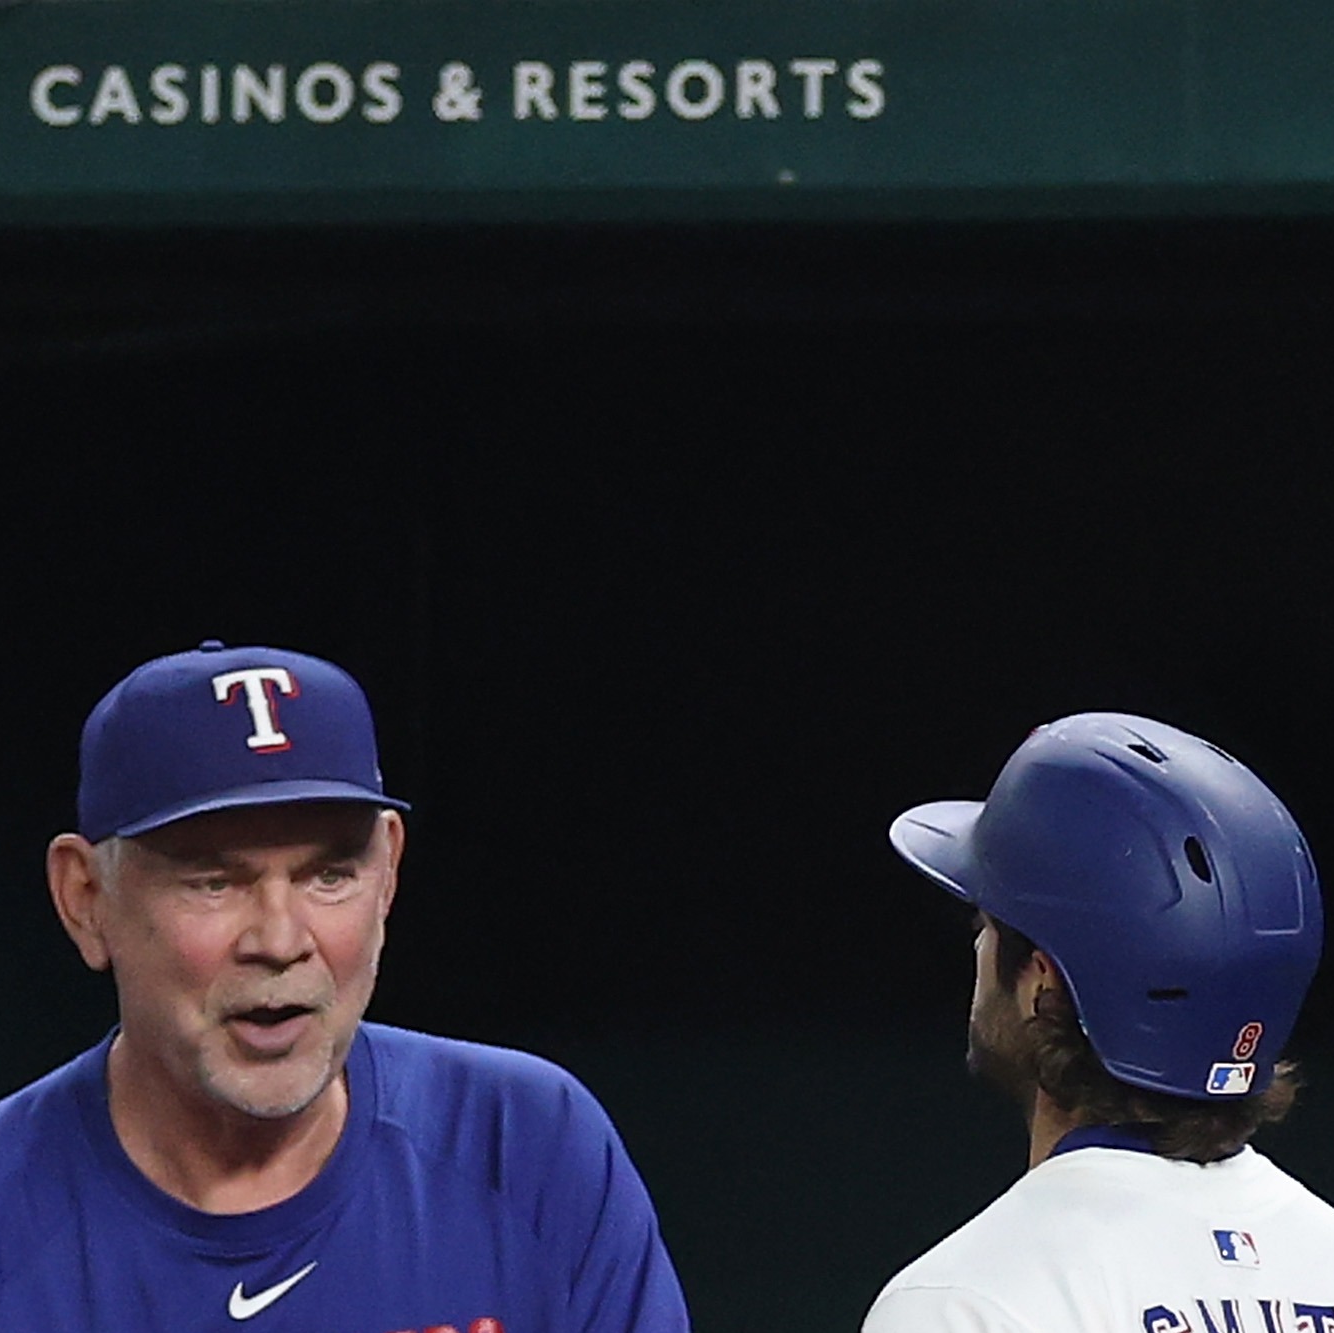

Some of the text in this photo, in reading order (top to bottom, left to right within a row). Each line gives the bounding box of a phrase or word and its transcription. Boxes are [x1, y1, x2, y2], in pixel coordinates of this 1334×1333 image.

[30, 63, 402, 126] CASINOS
[432, 64, 482, 121] &
[513, 59, 887, 120] RESORTS
[212, 668, 300, 754] T
[1233, 1022, 1263, 1060] 8
